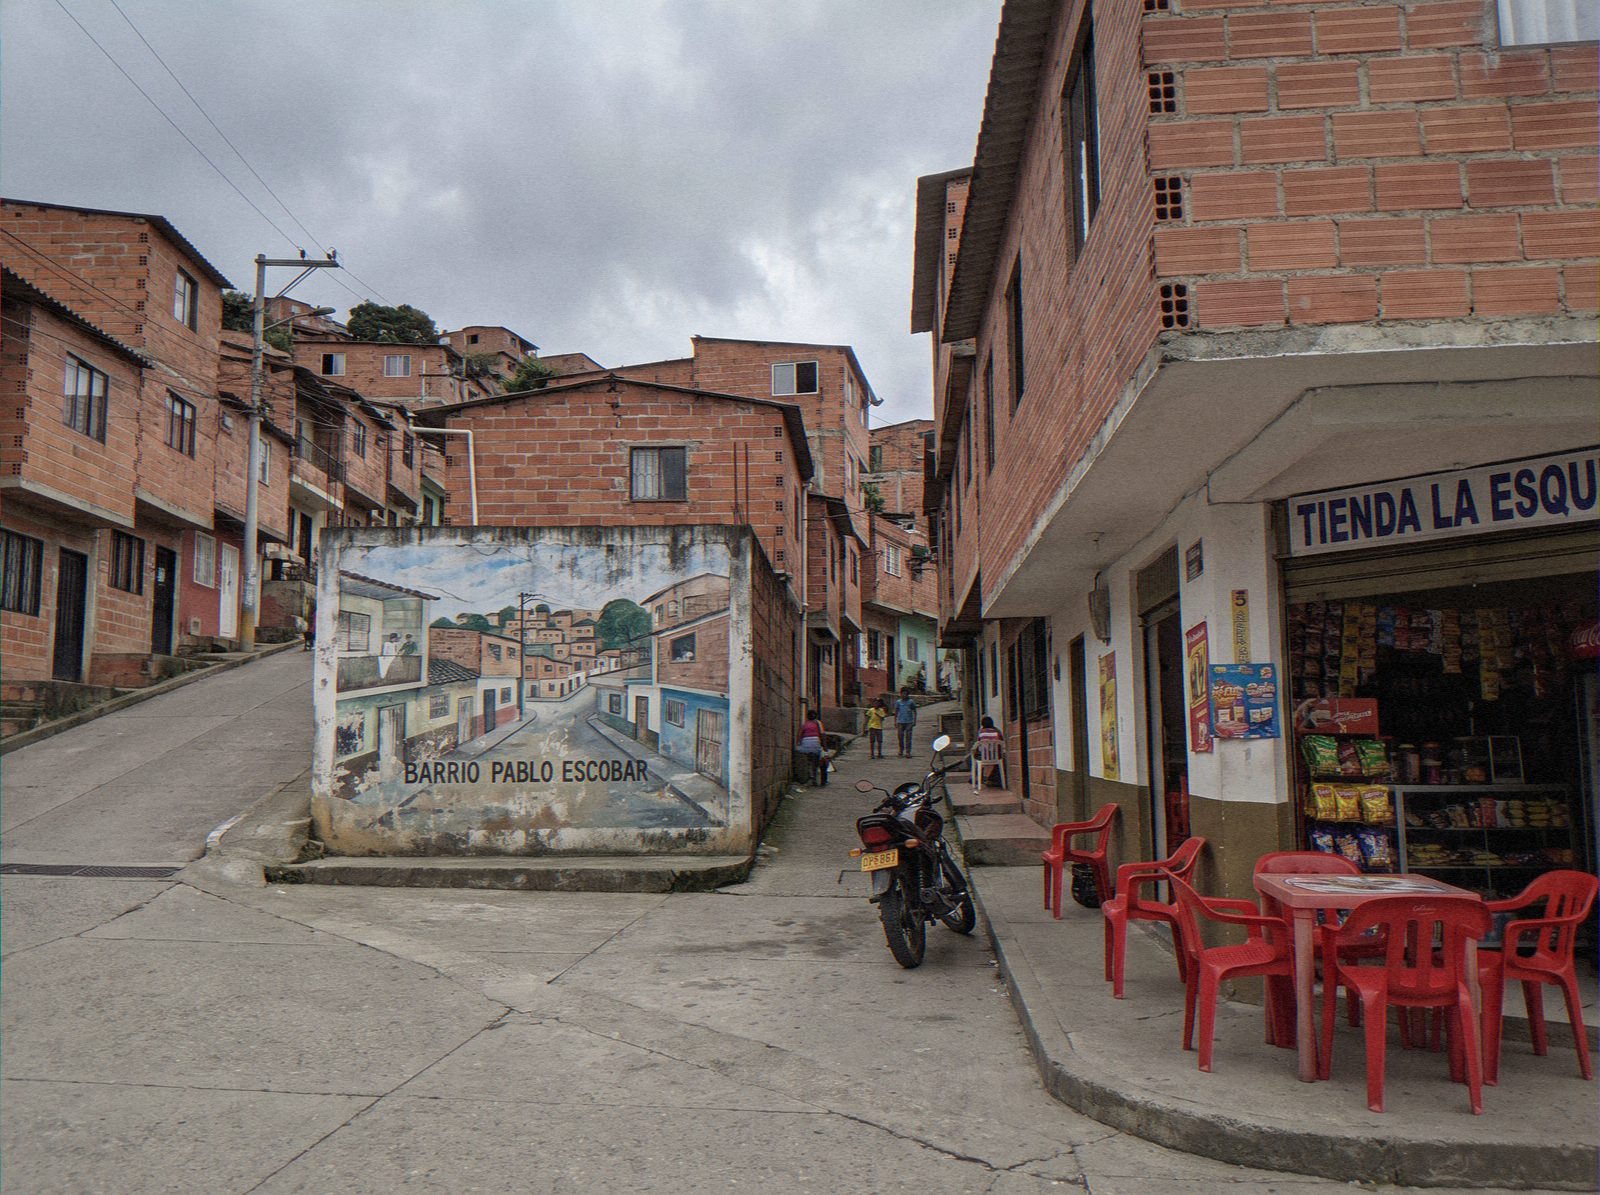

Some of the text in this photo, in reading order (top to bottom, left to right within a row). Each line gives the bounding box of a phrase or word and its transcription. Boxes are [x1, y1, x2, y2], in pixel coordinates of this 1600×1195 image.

[1296, 458, 1600, 546] TIENDA LA ESQU
[404, 759, 648, 784] BARRIO PABLO ESCOBAR
